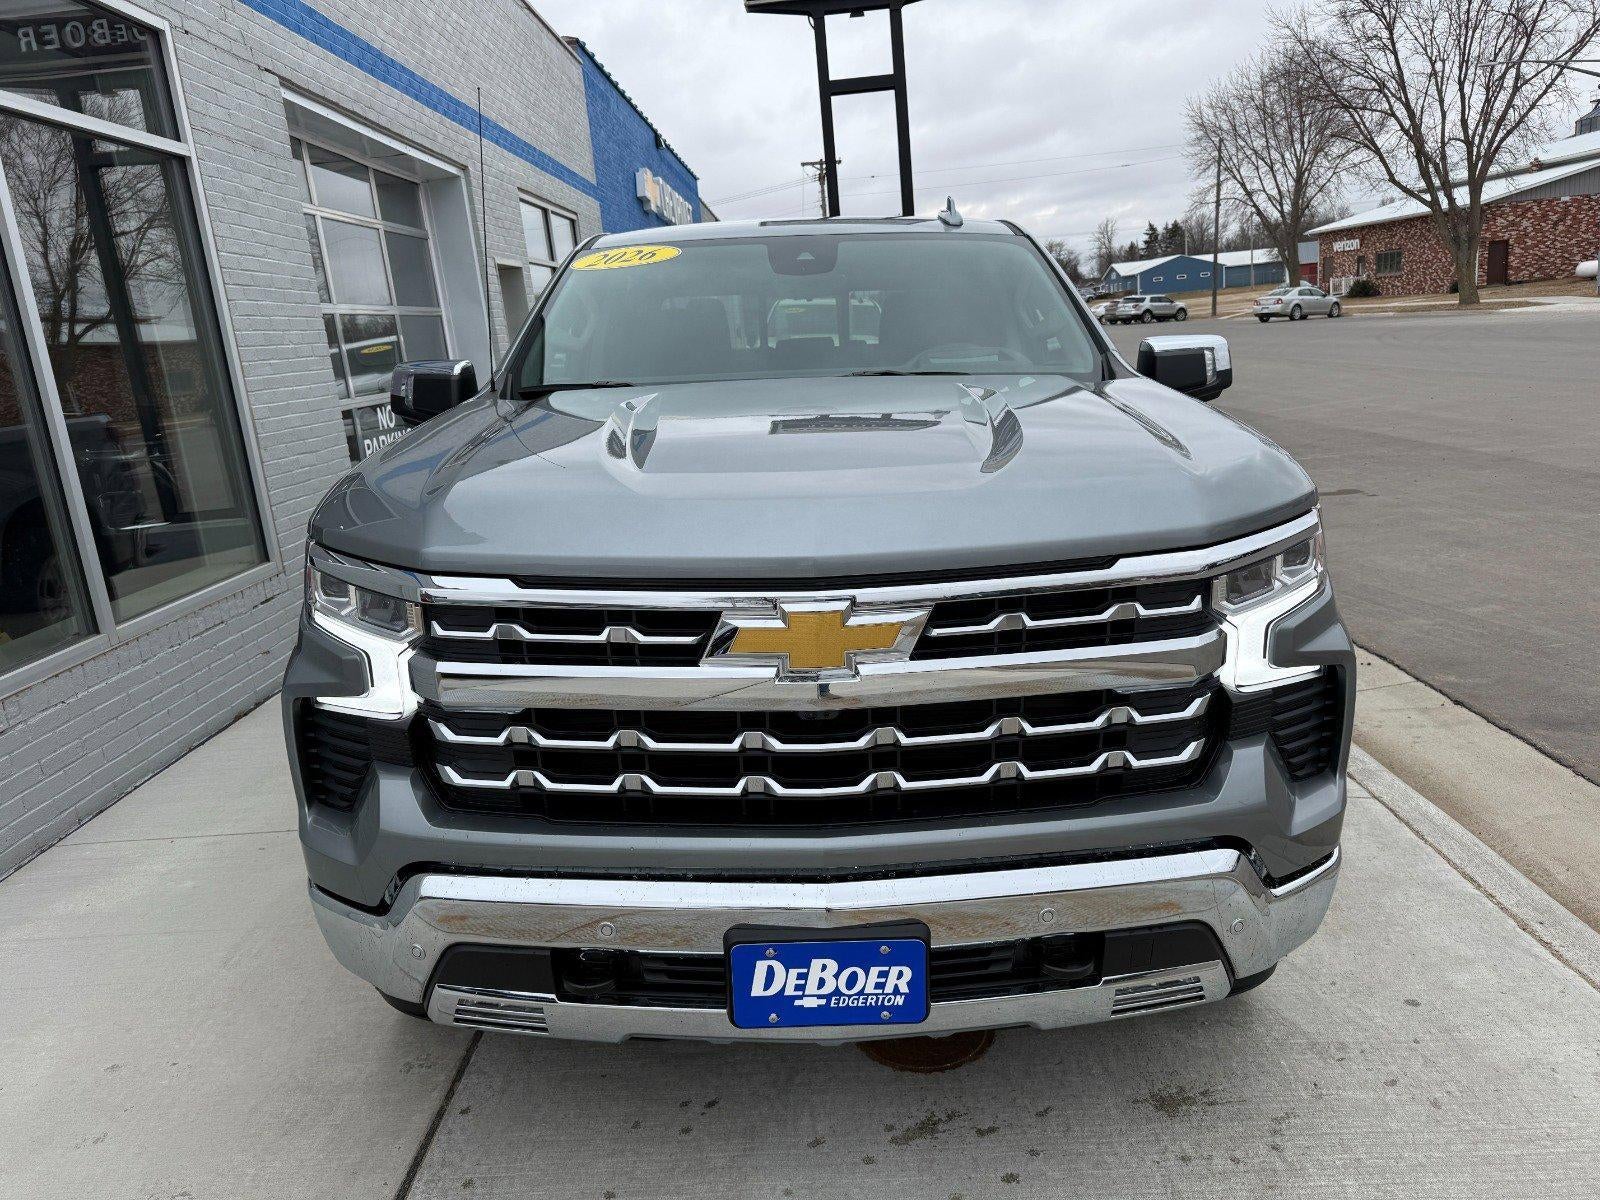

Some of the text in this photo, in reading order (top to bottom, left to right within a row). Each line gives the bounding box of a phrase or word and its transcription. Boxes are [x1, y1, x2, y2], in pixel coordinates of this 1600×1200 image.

[1333, 238, 1360, 252] verizon
[585, 249, 662, 268] 2026
[376, 404, 396, 430] NO
[830, 995, 905, 1008] EDGERTON
